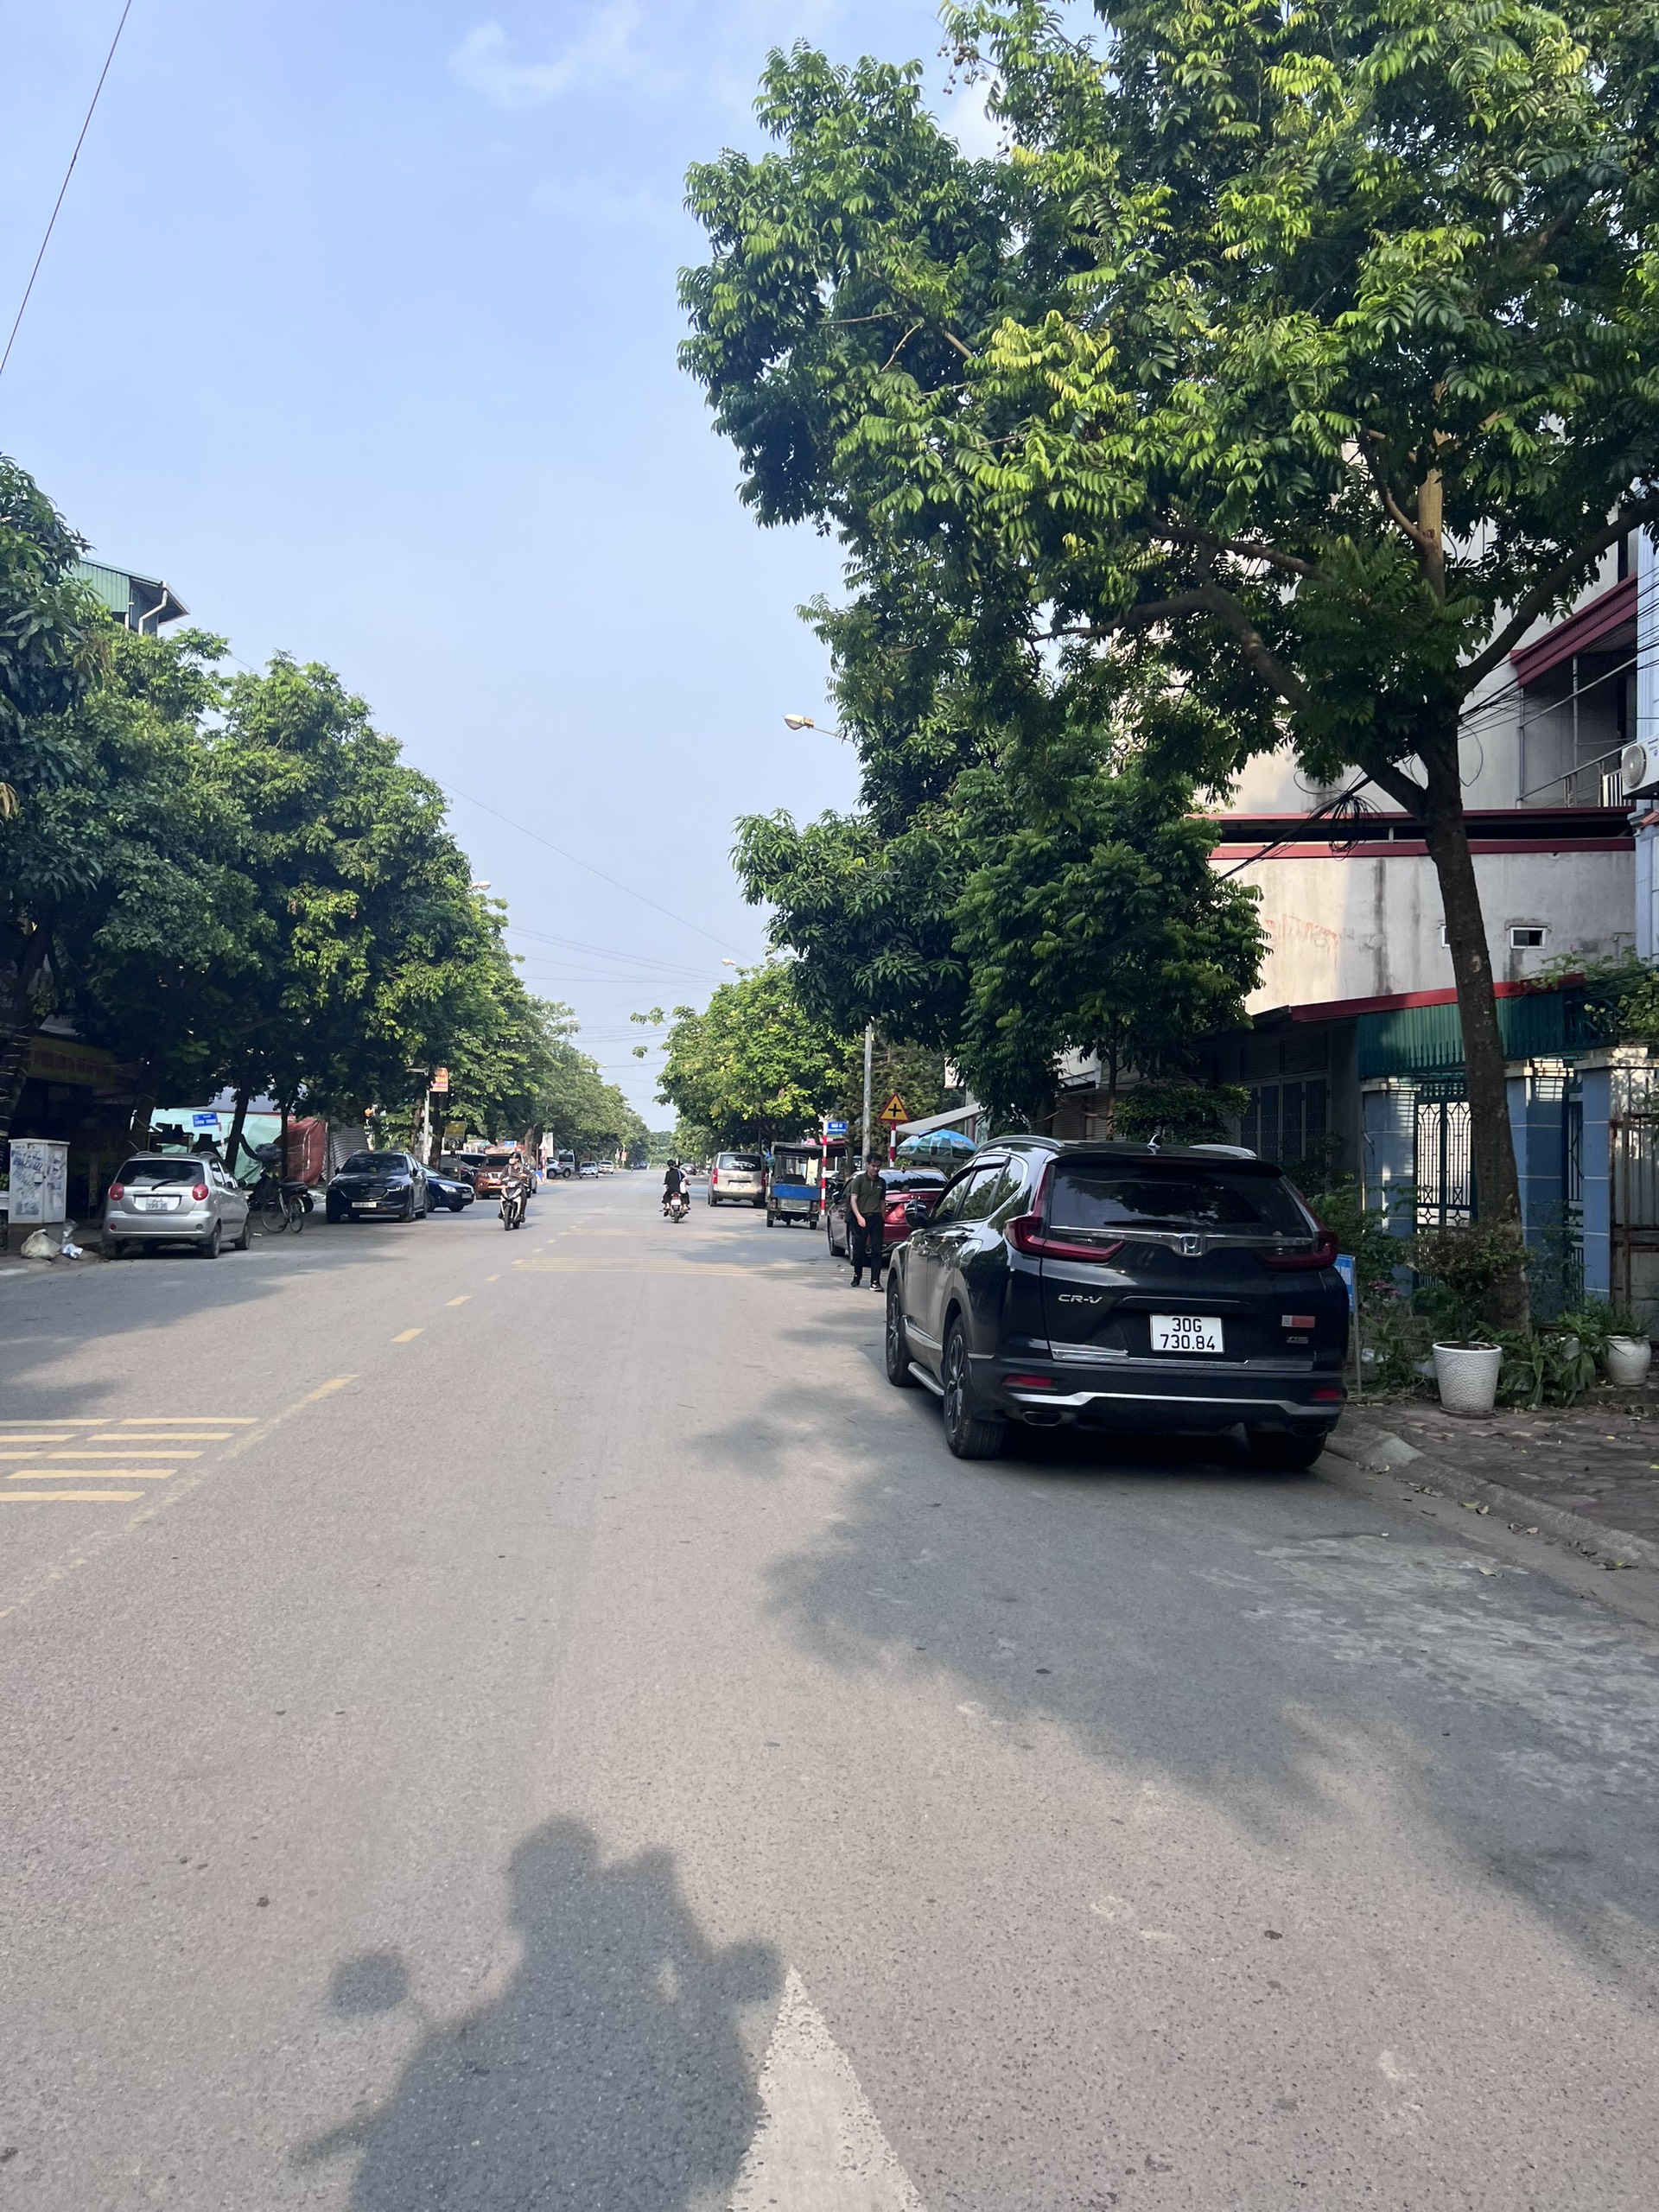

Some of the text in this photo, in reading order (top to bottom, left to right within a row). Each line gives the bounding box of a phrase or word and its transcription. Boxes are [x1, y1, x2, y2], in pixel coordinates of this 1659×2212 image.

[1058, 1294, 1103, 1304] CR-V
[1172, 1317, 1202, 1333] 30G
[1160, 1333, 1216, 1351] 730.84
